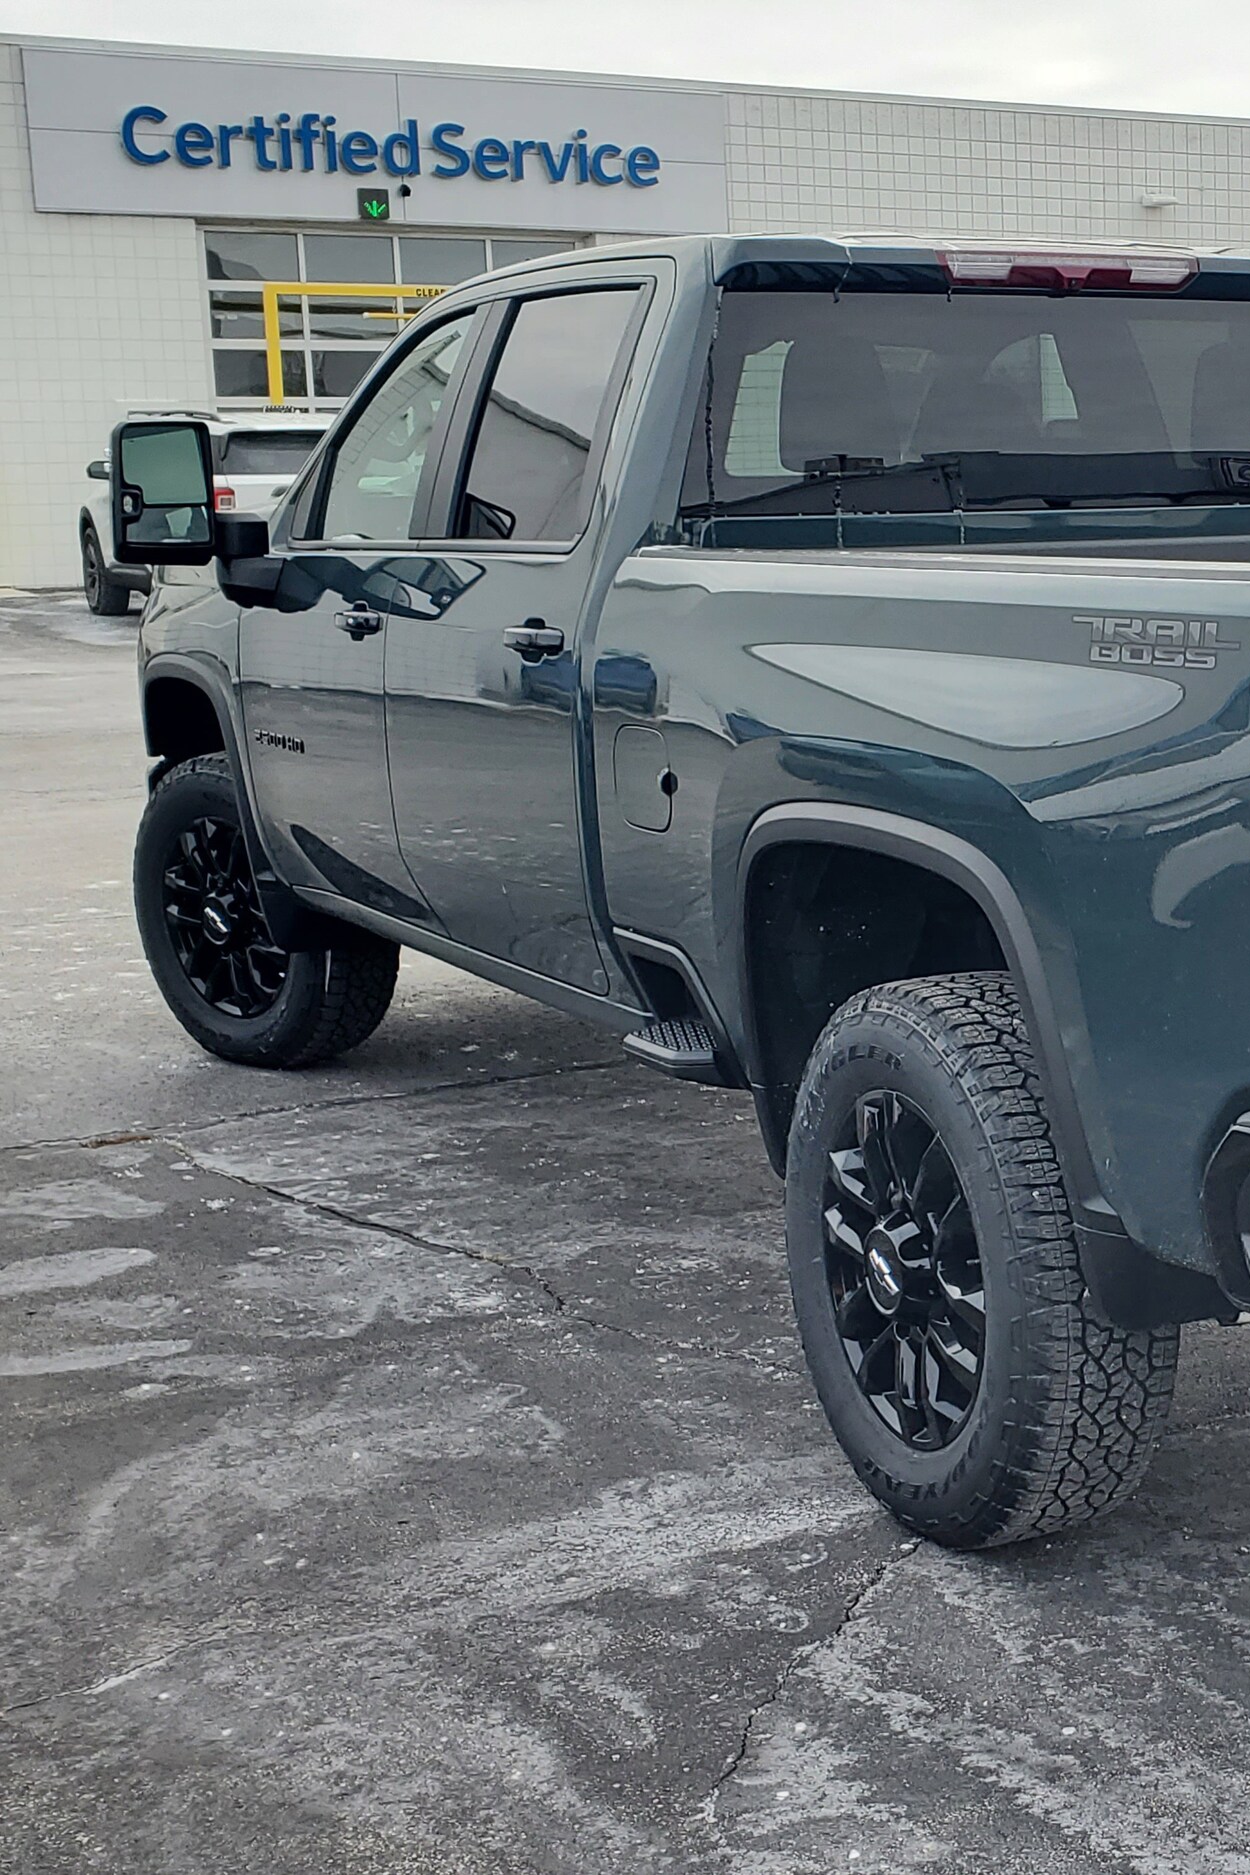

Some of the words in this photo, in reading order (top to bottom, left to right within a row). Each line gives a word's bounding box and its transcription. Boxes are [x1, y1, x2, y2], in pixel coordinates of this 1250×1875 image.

[121, 105, 420, 176] Certified
[430, 122, 660, 188] Service
[1072, 615, 1242, 650] TRAIL
[1089, 642, 1217, 669] BOSS
